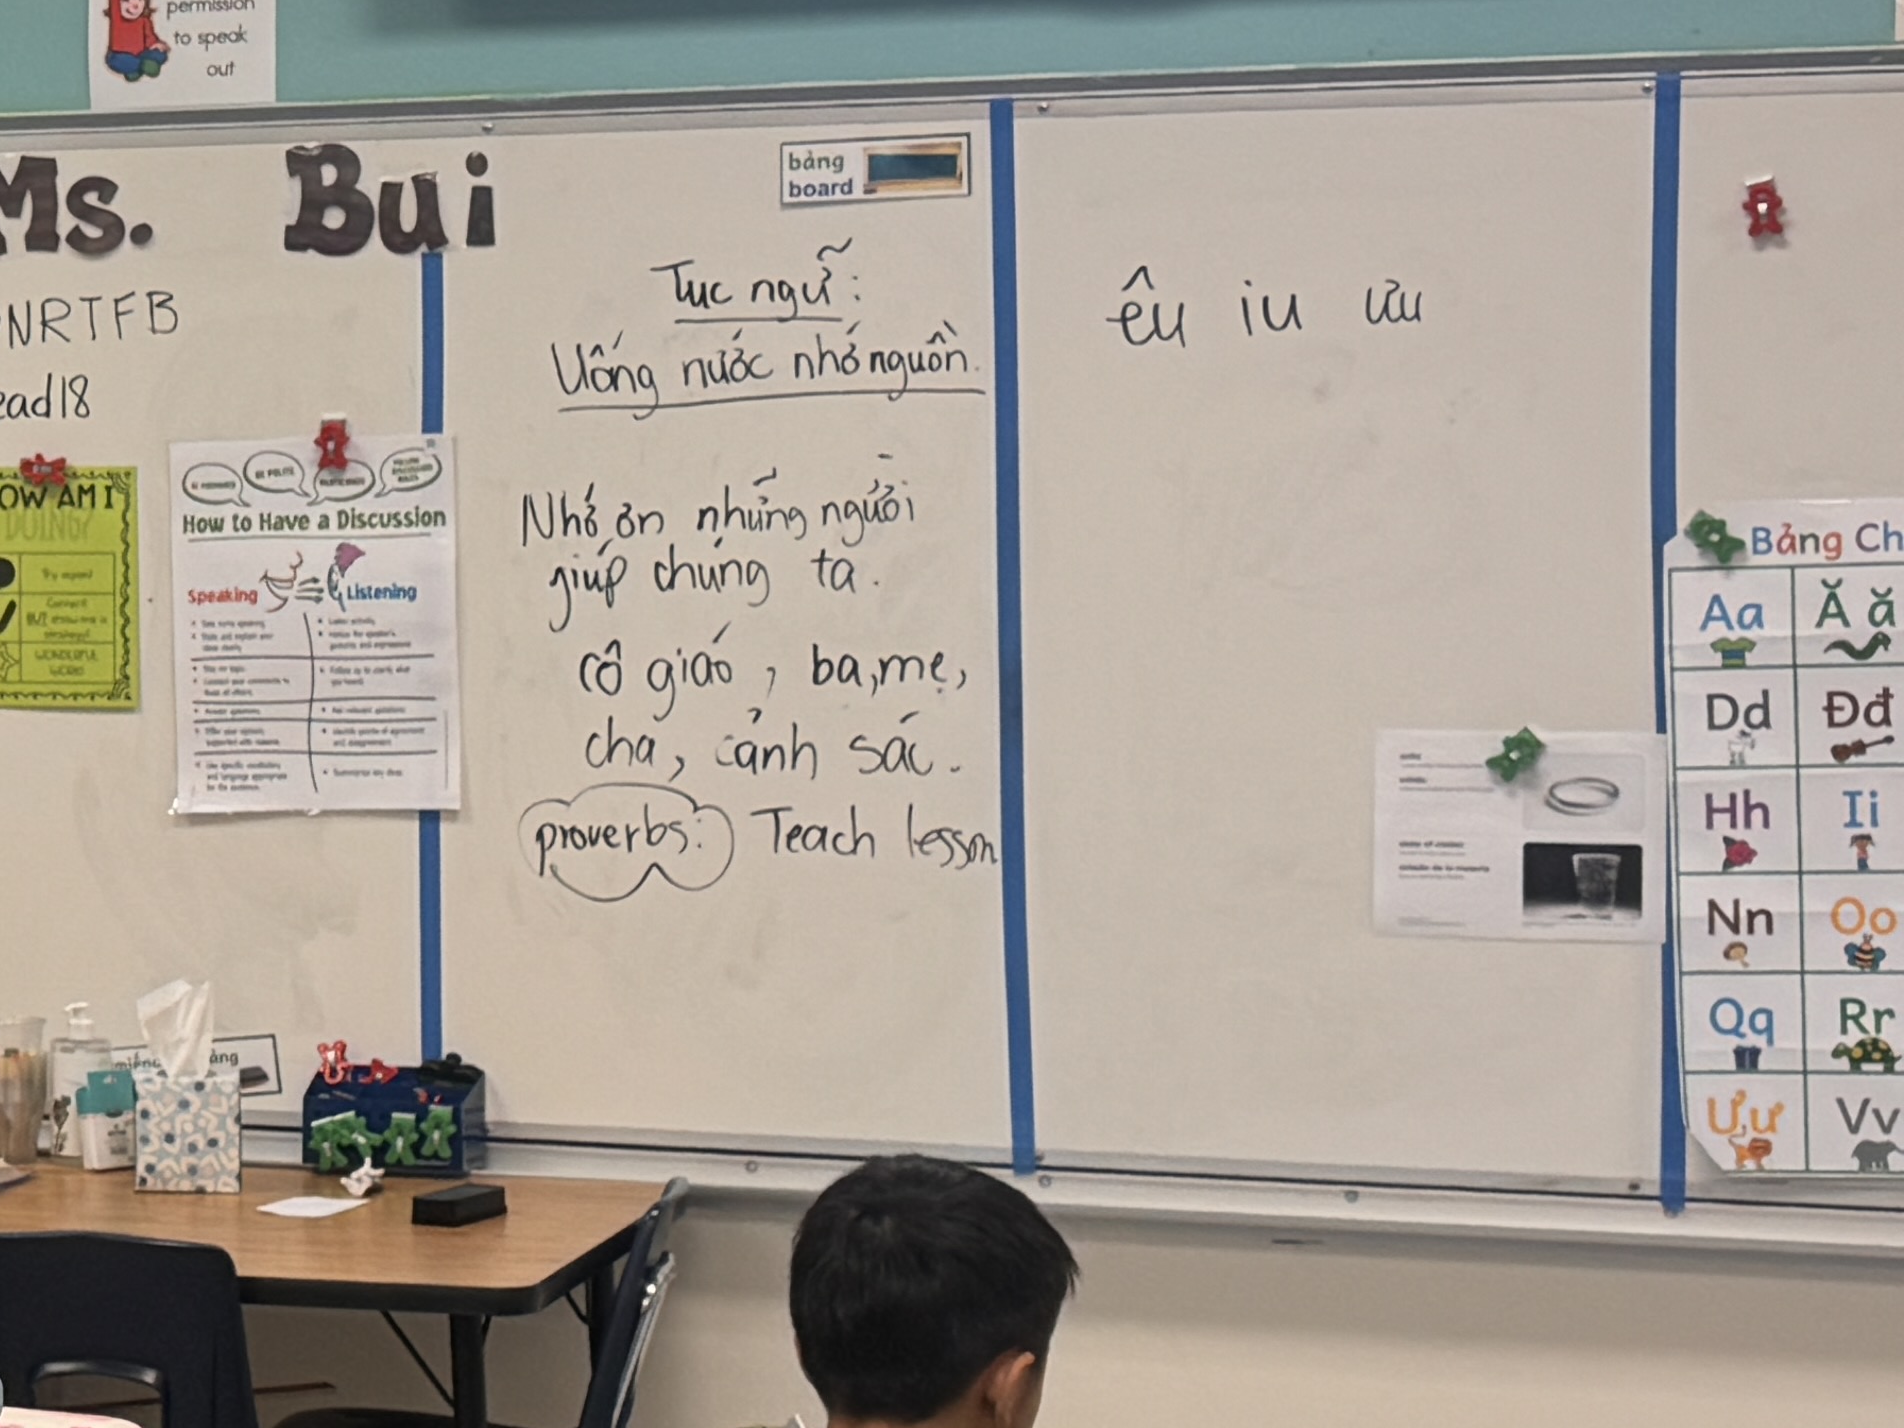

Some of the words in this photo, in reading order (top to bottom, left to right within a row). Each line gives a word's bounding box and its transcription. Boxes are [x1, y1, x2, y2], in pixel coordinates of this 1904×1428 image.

[174, 29, 192, 46] to
[197, 24, 247, 52] speak
[206, 61, 235, 77] out
[789, 150, 844, 173] bảng
[283, 143, 496, 257] Bui
[789, 178, 853, 198] board
[1106, 265, 1186, 348] êu
[1242, 279, 1302, 336] iu
[1365, 279, 1422, 323] ưu
[551, 330, 658, 420] Uống
[682, 328, 773, 389] nước
[794, 320, 861, 379] nhớ
[57, 484, 96, 509] AM
[104, 485, 114, 509] I
[522, 482, 599, 547] Nhớ
[697, 468, 807, 540] những
[5, 509, 90, 542] DOING?
[183, 514, 225, 534] How
[232, 513, 252, 532] to
[260, 512, 310, 531] Have
[318, 515, 330, 530] a
[337, 505, 447, 529] Discussion
[1751, 522, 1843, 561] Bảng
[187, 588, 259, 606] Speaking
[347, 583, 418, 602] Listening
[548, 537, 628, 633] giúp
[654, 536, 770, 607] chúng
[1699, 593, 1765, 632] Aa
[1706, 688, 1772, 731] Dd
[1822, 685, 1895, 729] Đđ
[1704, 788, 1771, 830] Hh
[1841, 789, 1880, 829] Ii
[750, 803, 875, 858] Teach
[908, 803, 998, 870] lesson
[1707, 898, 1774, 936] Nn
[1830, 896, 1898, 936] Oo
[1709, 997, 1775, 1047] Qq
[1839, 997, 1896, 1036] Rr
[209, 1049, 239, 1066] ảng
[1707, 1089, 1785, 1135] Ưư
[1835, 1097, 1900, 1135] Vv
